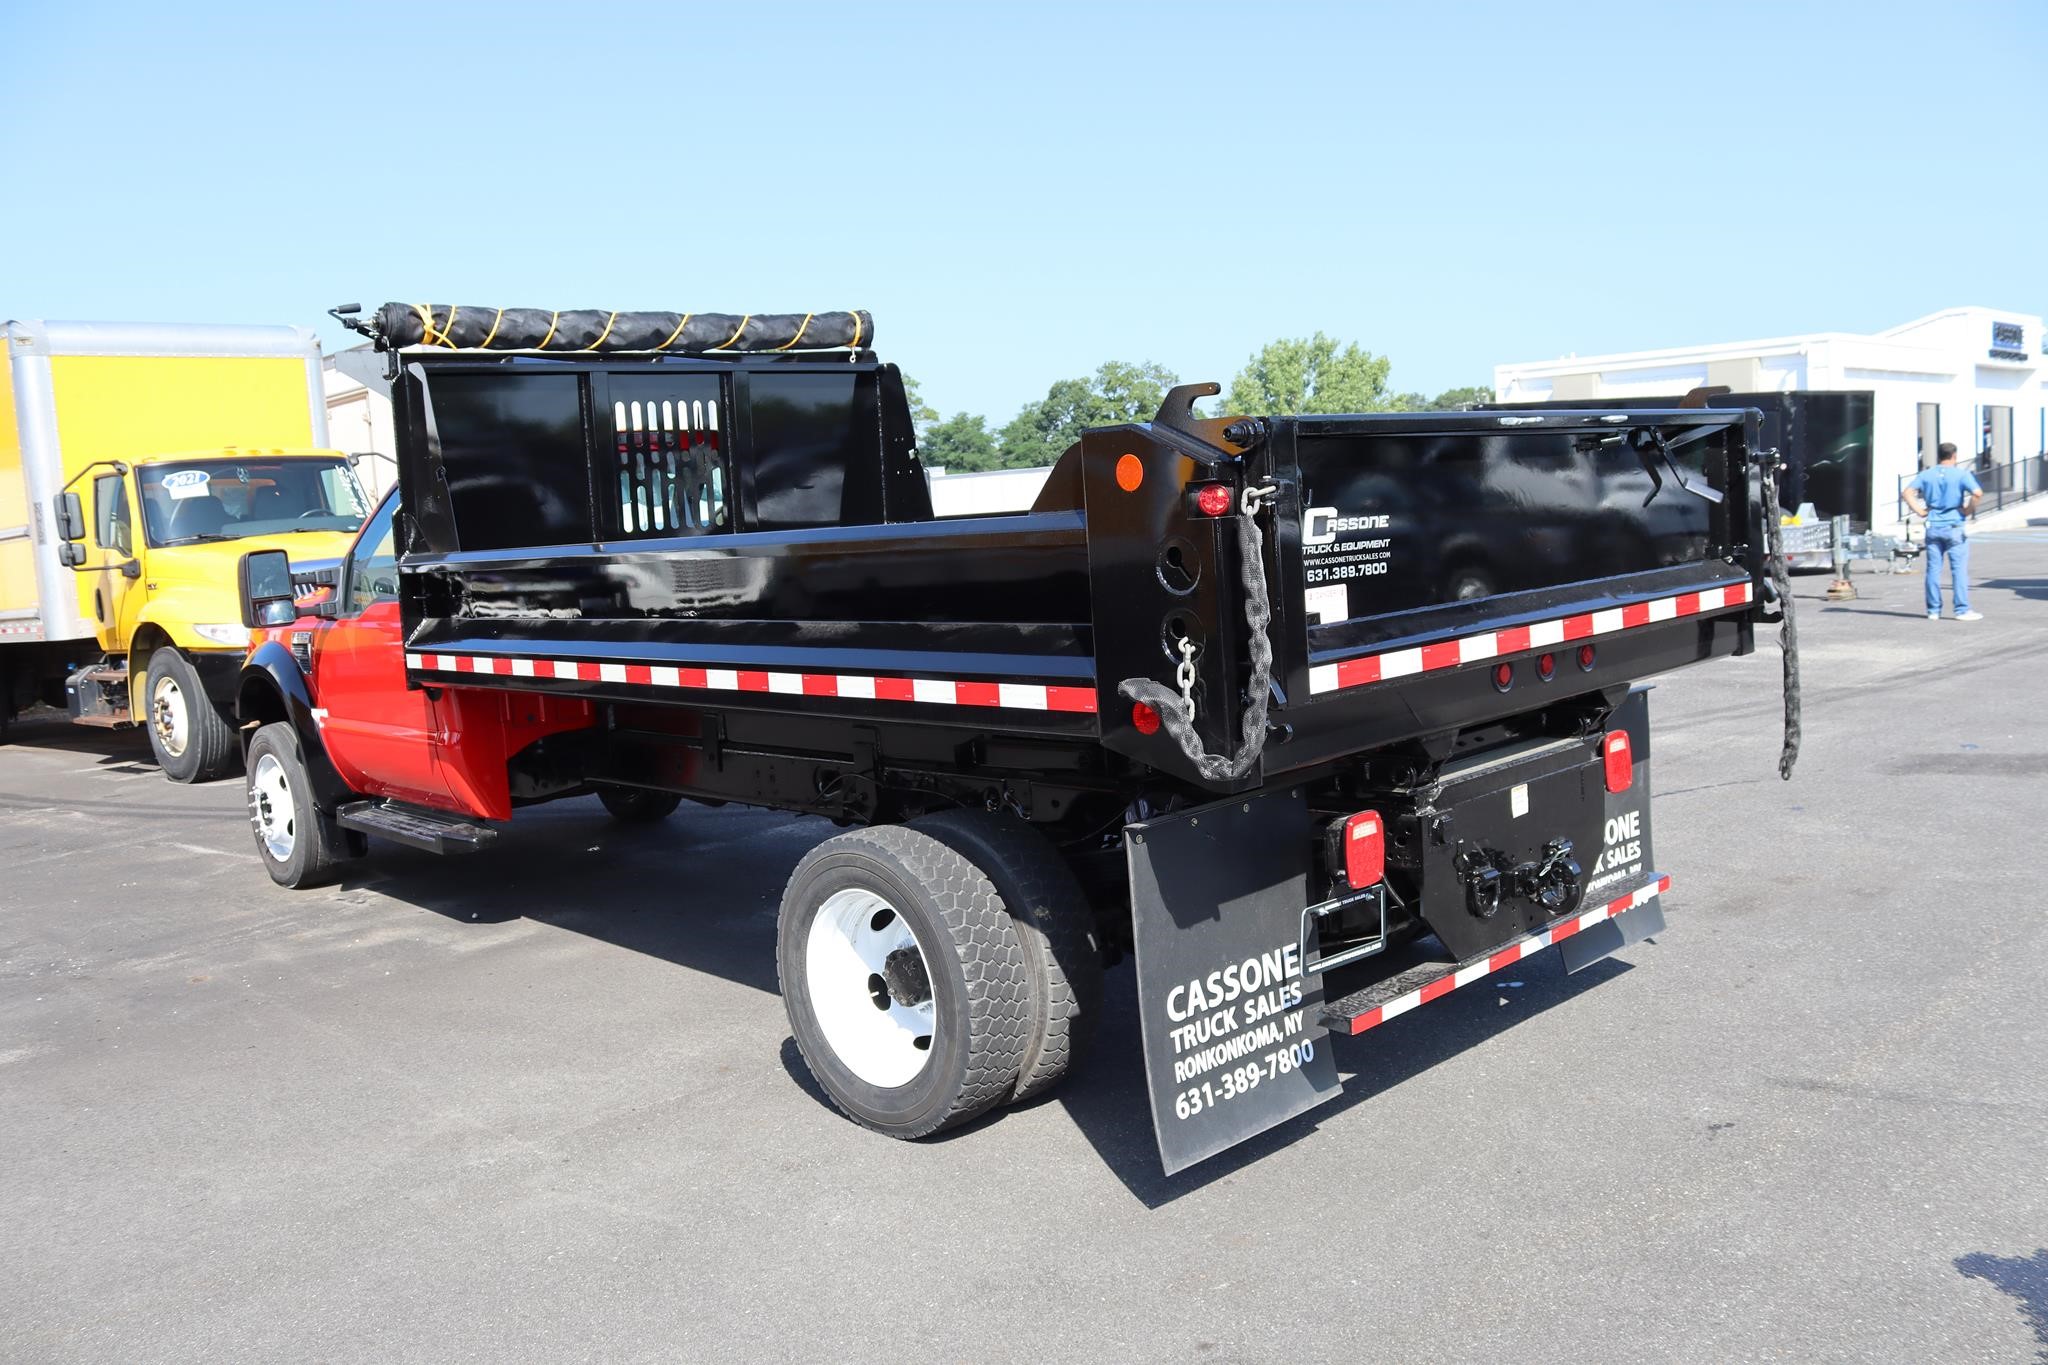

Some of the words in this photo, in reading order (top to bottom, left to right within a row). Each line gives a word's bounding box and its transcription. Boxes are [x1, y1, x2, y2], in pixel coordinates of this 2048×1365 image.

[1302, 543, 1332, 555] TRUCK
[1333, 543, 1340, 553] &
[1341, 539, 1391, 551] EQUIPMENT
[1307, 562, 1387, 582] 631.389.7800
[1604, 810, 1641, 846] ONE
[1607, 840, 1642, 869] SALES
[1166, 942, 1300, 1023] CASSONE
[1169, 1009, 1238, 1054] TRUCK
[1245, 982, 1303, 1024] SALES
[1174, 1026, 1284, 1084] RONKONKOMA,
[1284, 1010, 1305, 1038] NY
[1175, 1038, 1315, 1120] 631-389-7800
